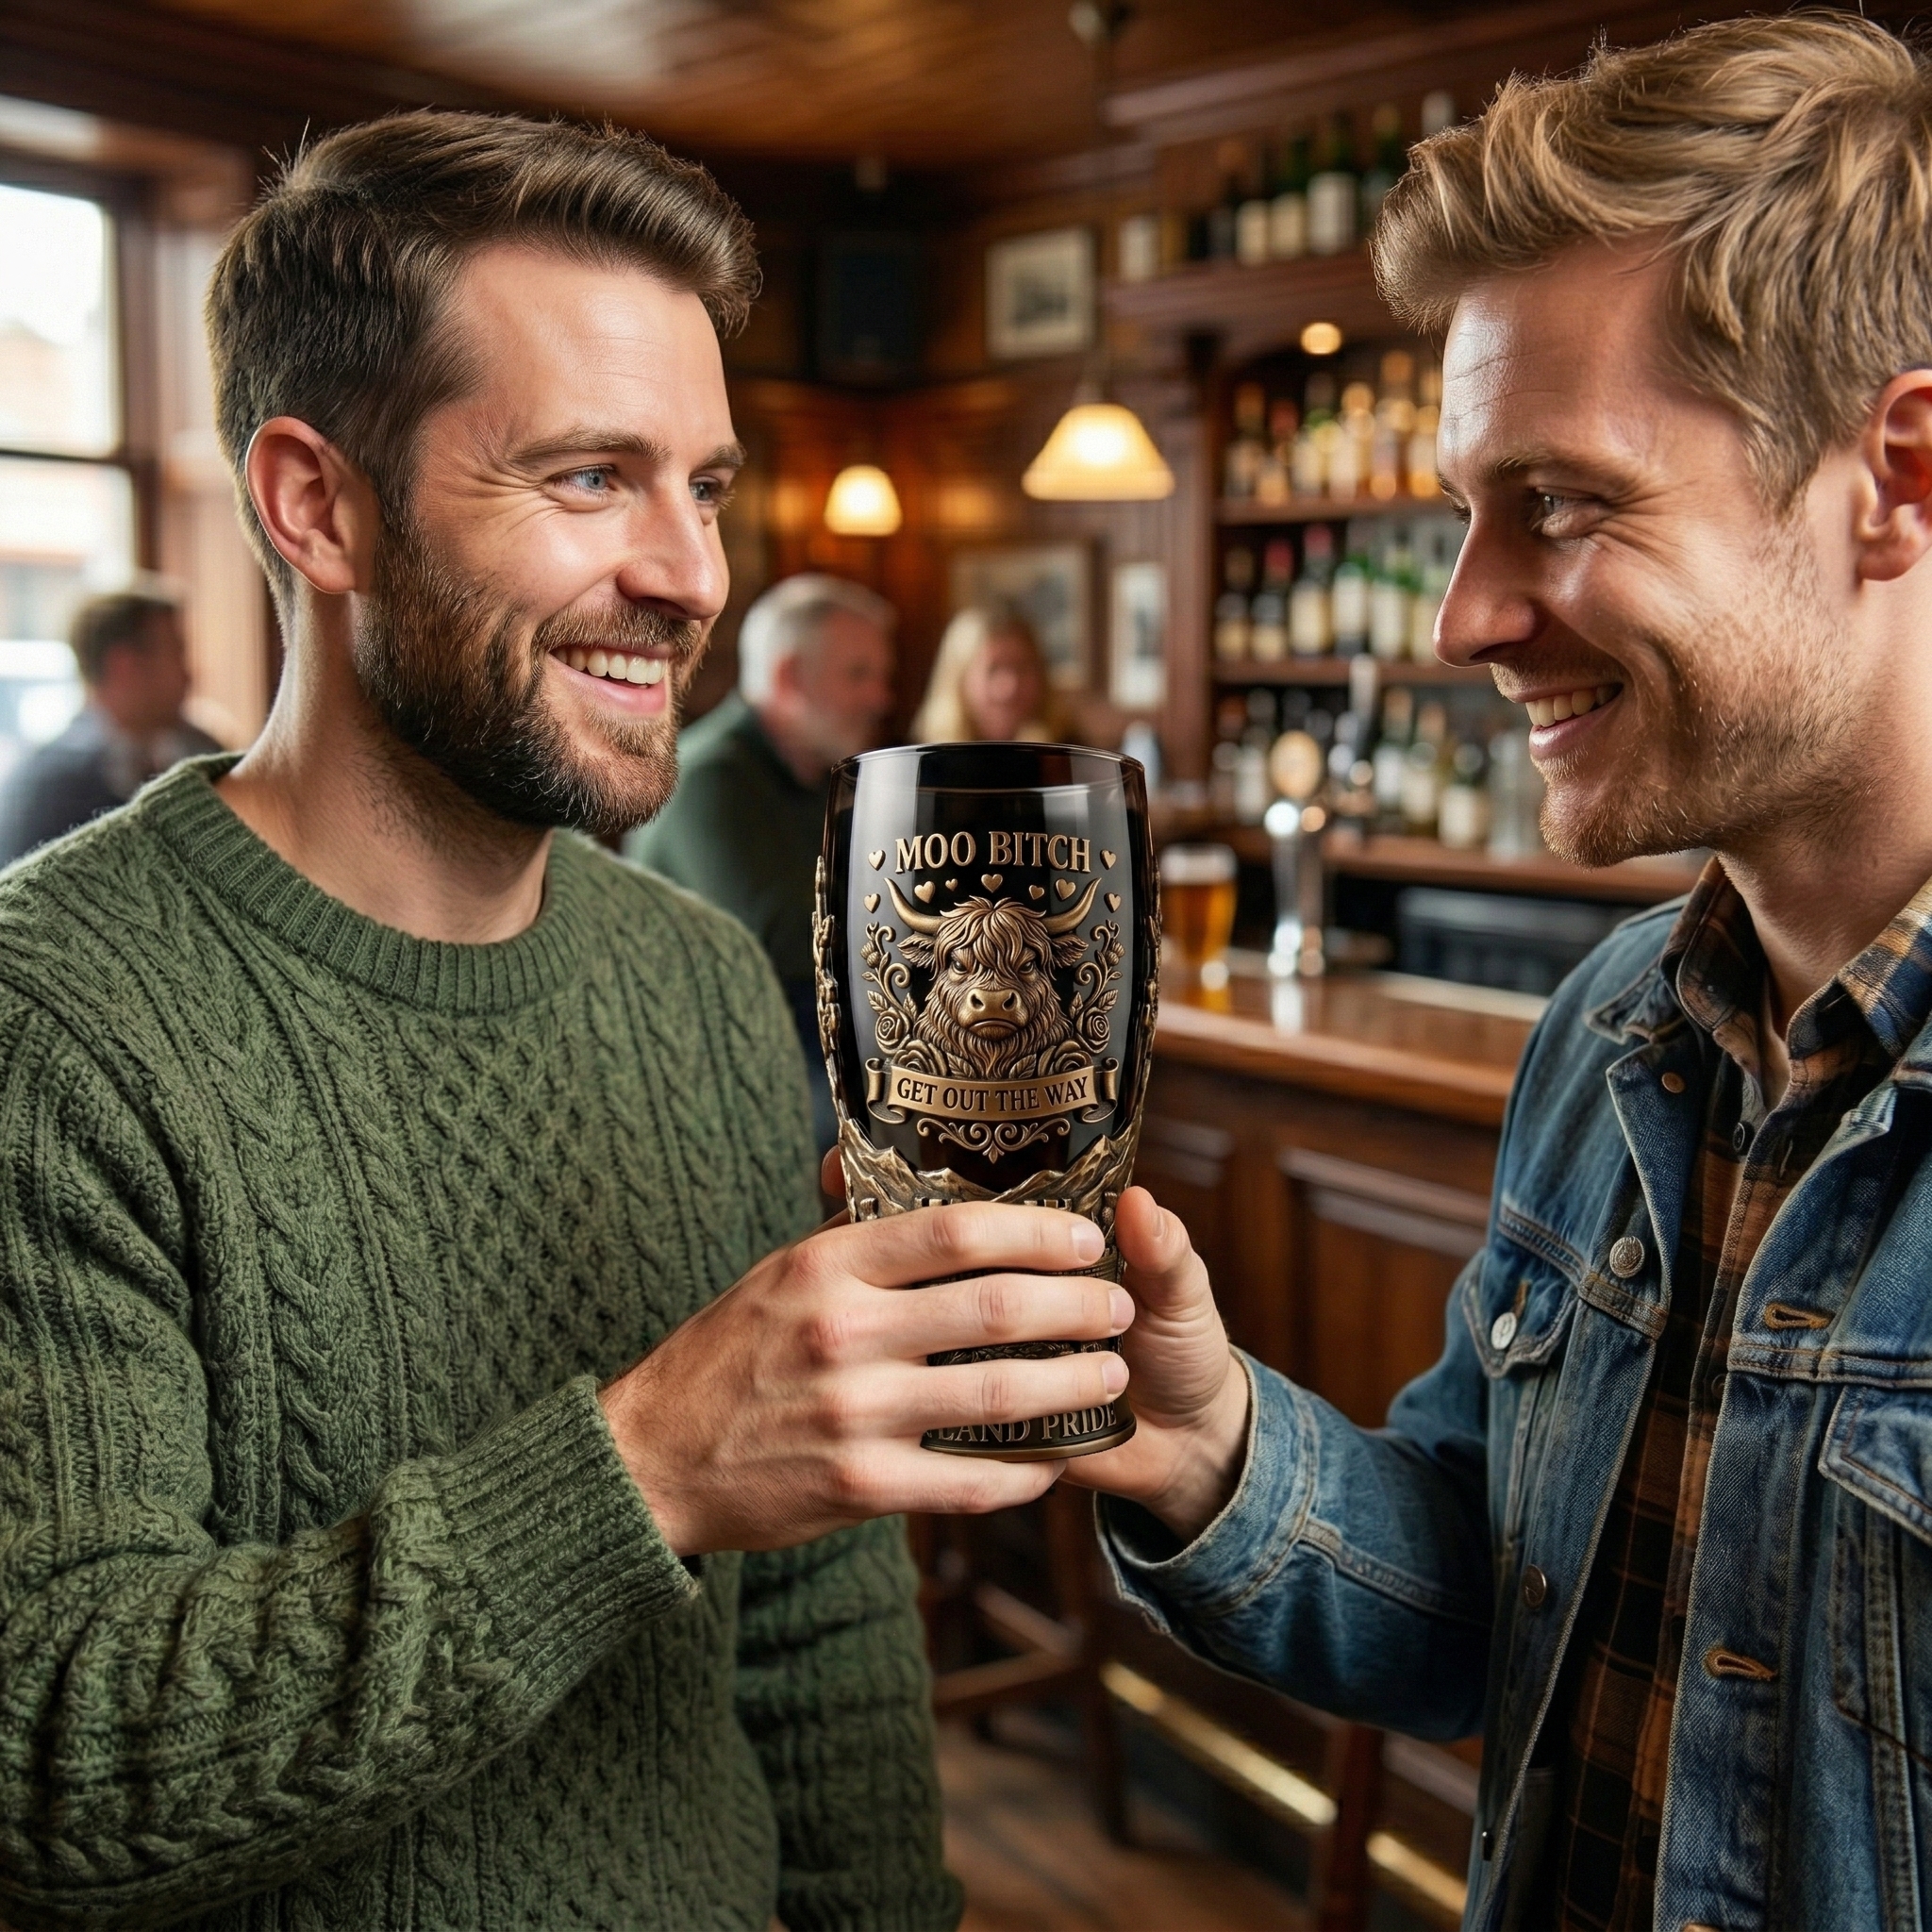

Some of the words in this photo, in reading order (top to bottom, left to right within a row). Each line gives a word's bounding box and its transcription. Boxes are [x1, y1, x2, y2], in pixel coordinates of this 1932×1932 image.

[895, 831, 976, 873] MOO
[989, 831, 1091, 873] BITCH
[897, 1077, 938, 1105] GET
[943, 1087, 990, 1111] OUT
[994, 1087, 1040, 1111] THE
[1044, 1076, 1089, 1107] WAY
[926, 1420, 1031, 1442] LAND
[1041, 1402, 1117, 1440] PRIDE
